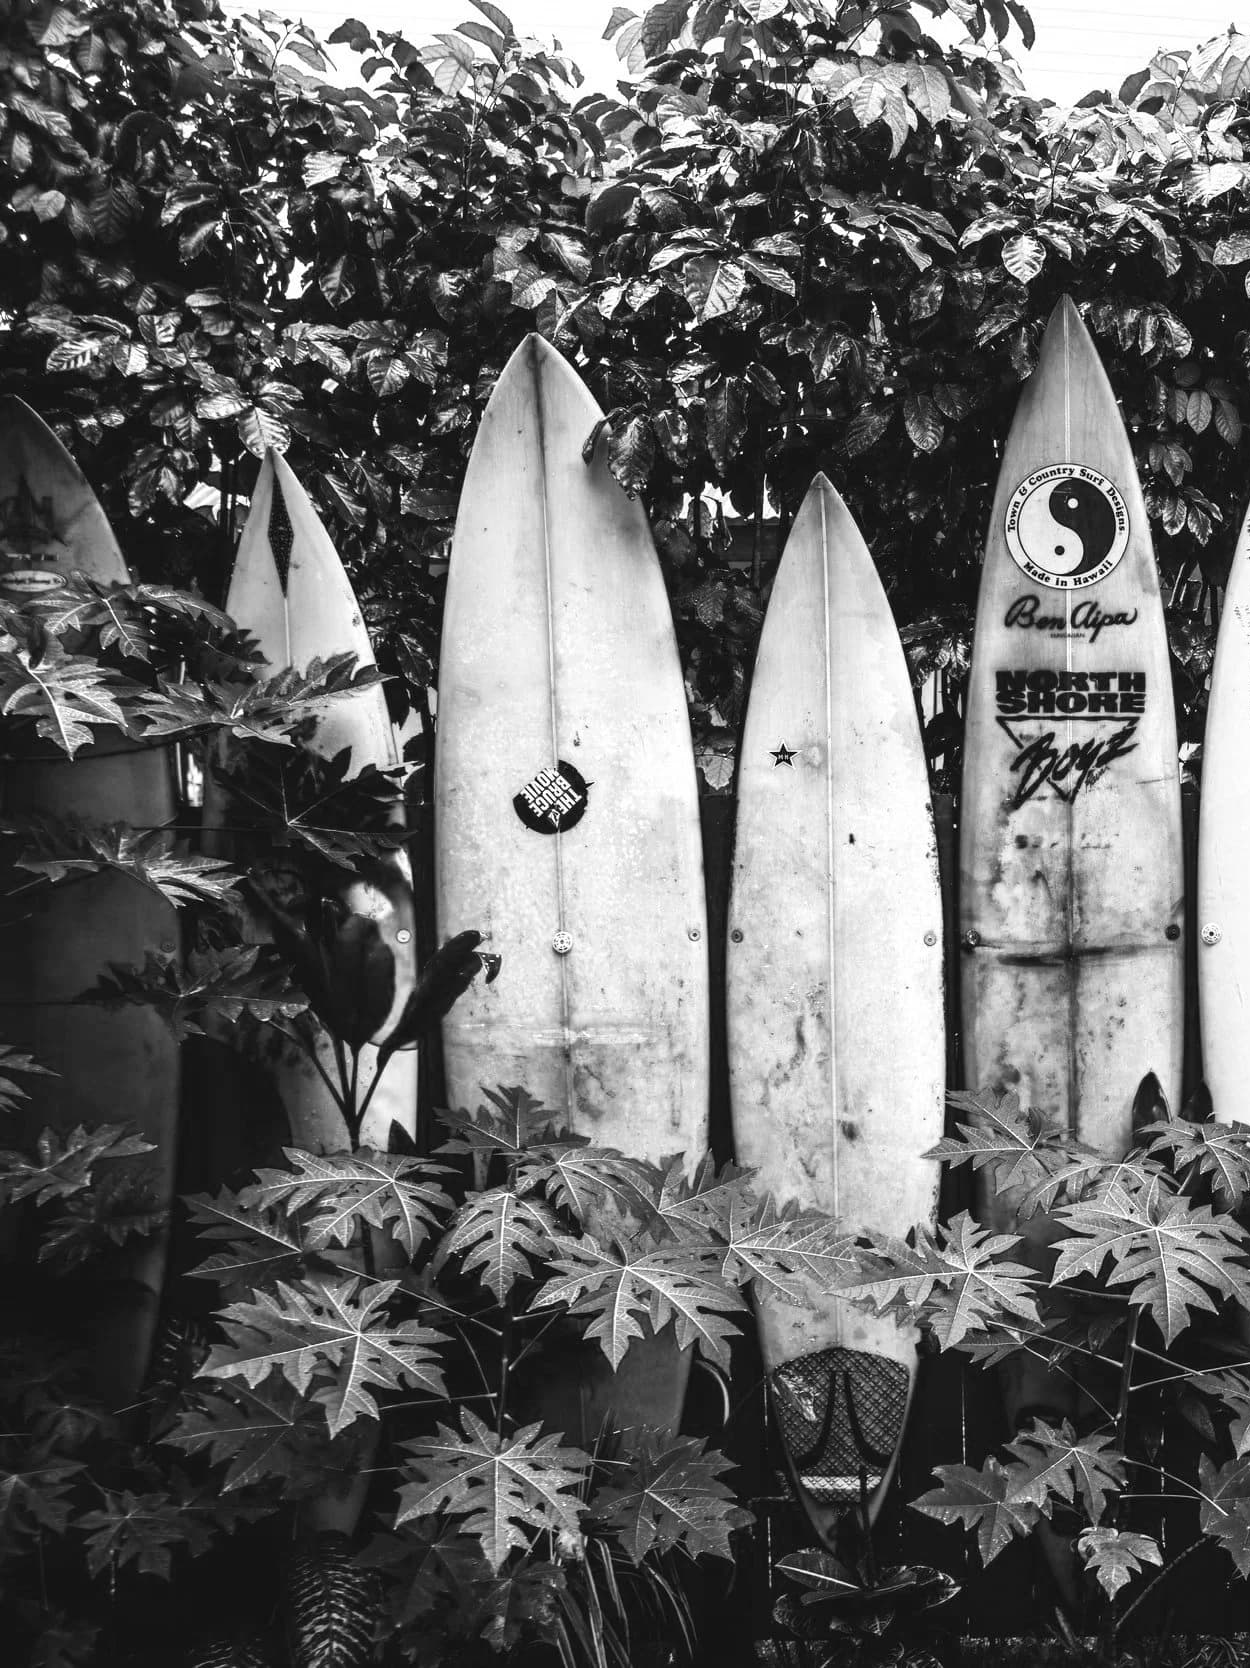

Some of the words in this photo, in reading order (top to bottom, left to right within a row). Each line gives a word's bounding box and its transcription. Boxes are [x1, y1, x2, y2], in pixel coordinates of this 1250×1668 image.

[1007, 500, 1021, 532] Town
[1019, 487, 1028, 497] &
[1028, 467, 1075, 486] Country
[1079, 468, 1105, 486] Surf
[1106, 487, 1126, 532] Designs
[1023, 561, 1050, 583] Made
[1055, 577, 1068, 587] in
[1073, 559, 1113, 586] Hawaii
[1004, 594, 1066, 630] Ben
[1071, 600, 1138, 643] Aipa
[995, 670, 1146, 692] NORTH
[995, 691, 1147, 714] SHORE
[520, 767, 560, 803] MOVIE
[528, 775, 572, 818] BRUCE
[553, 788, 582, 815] THE
